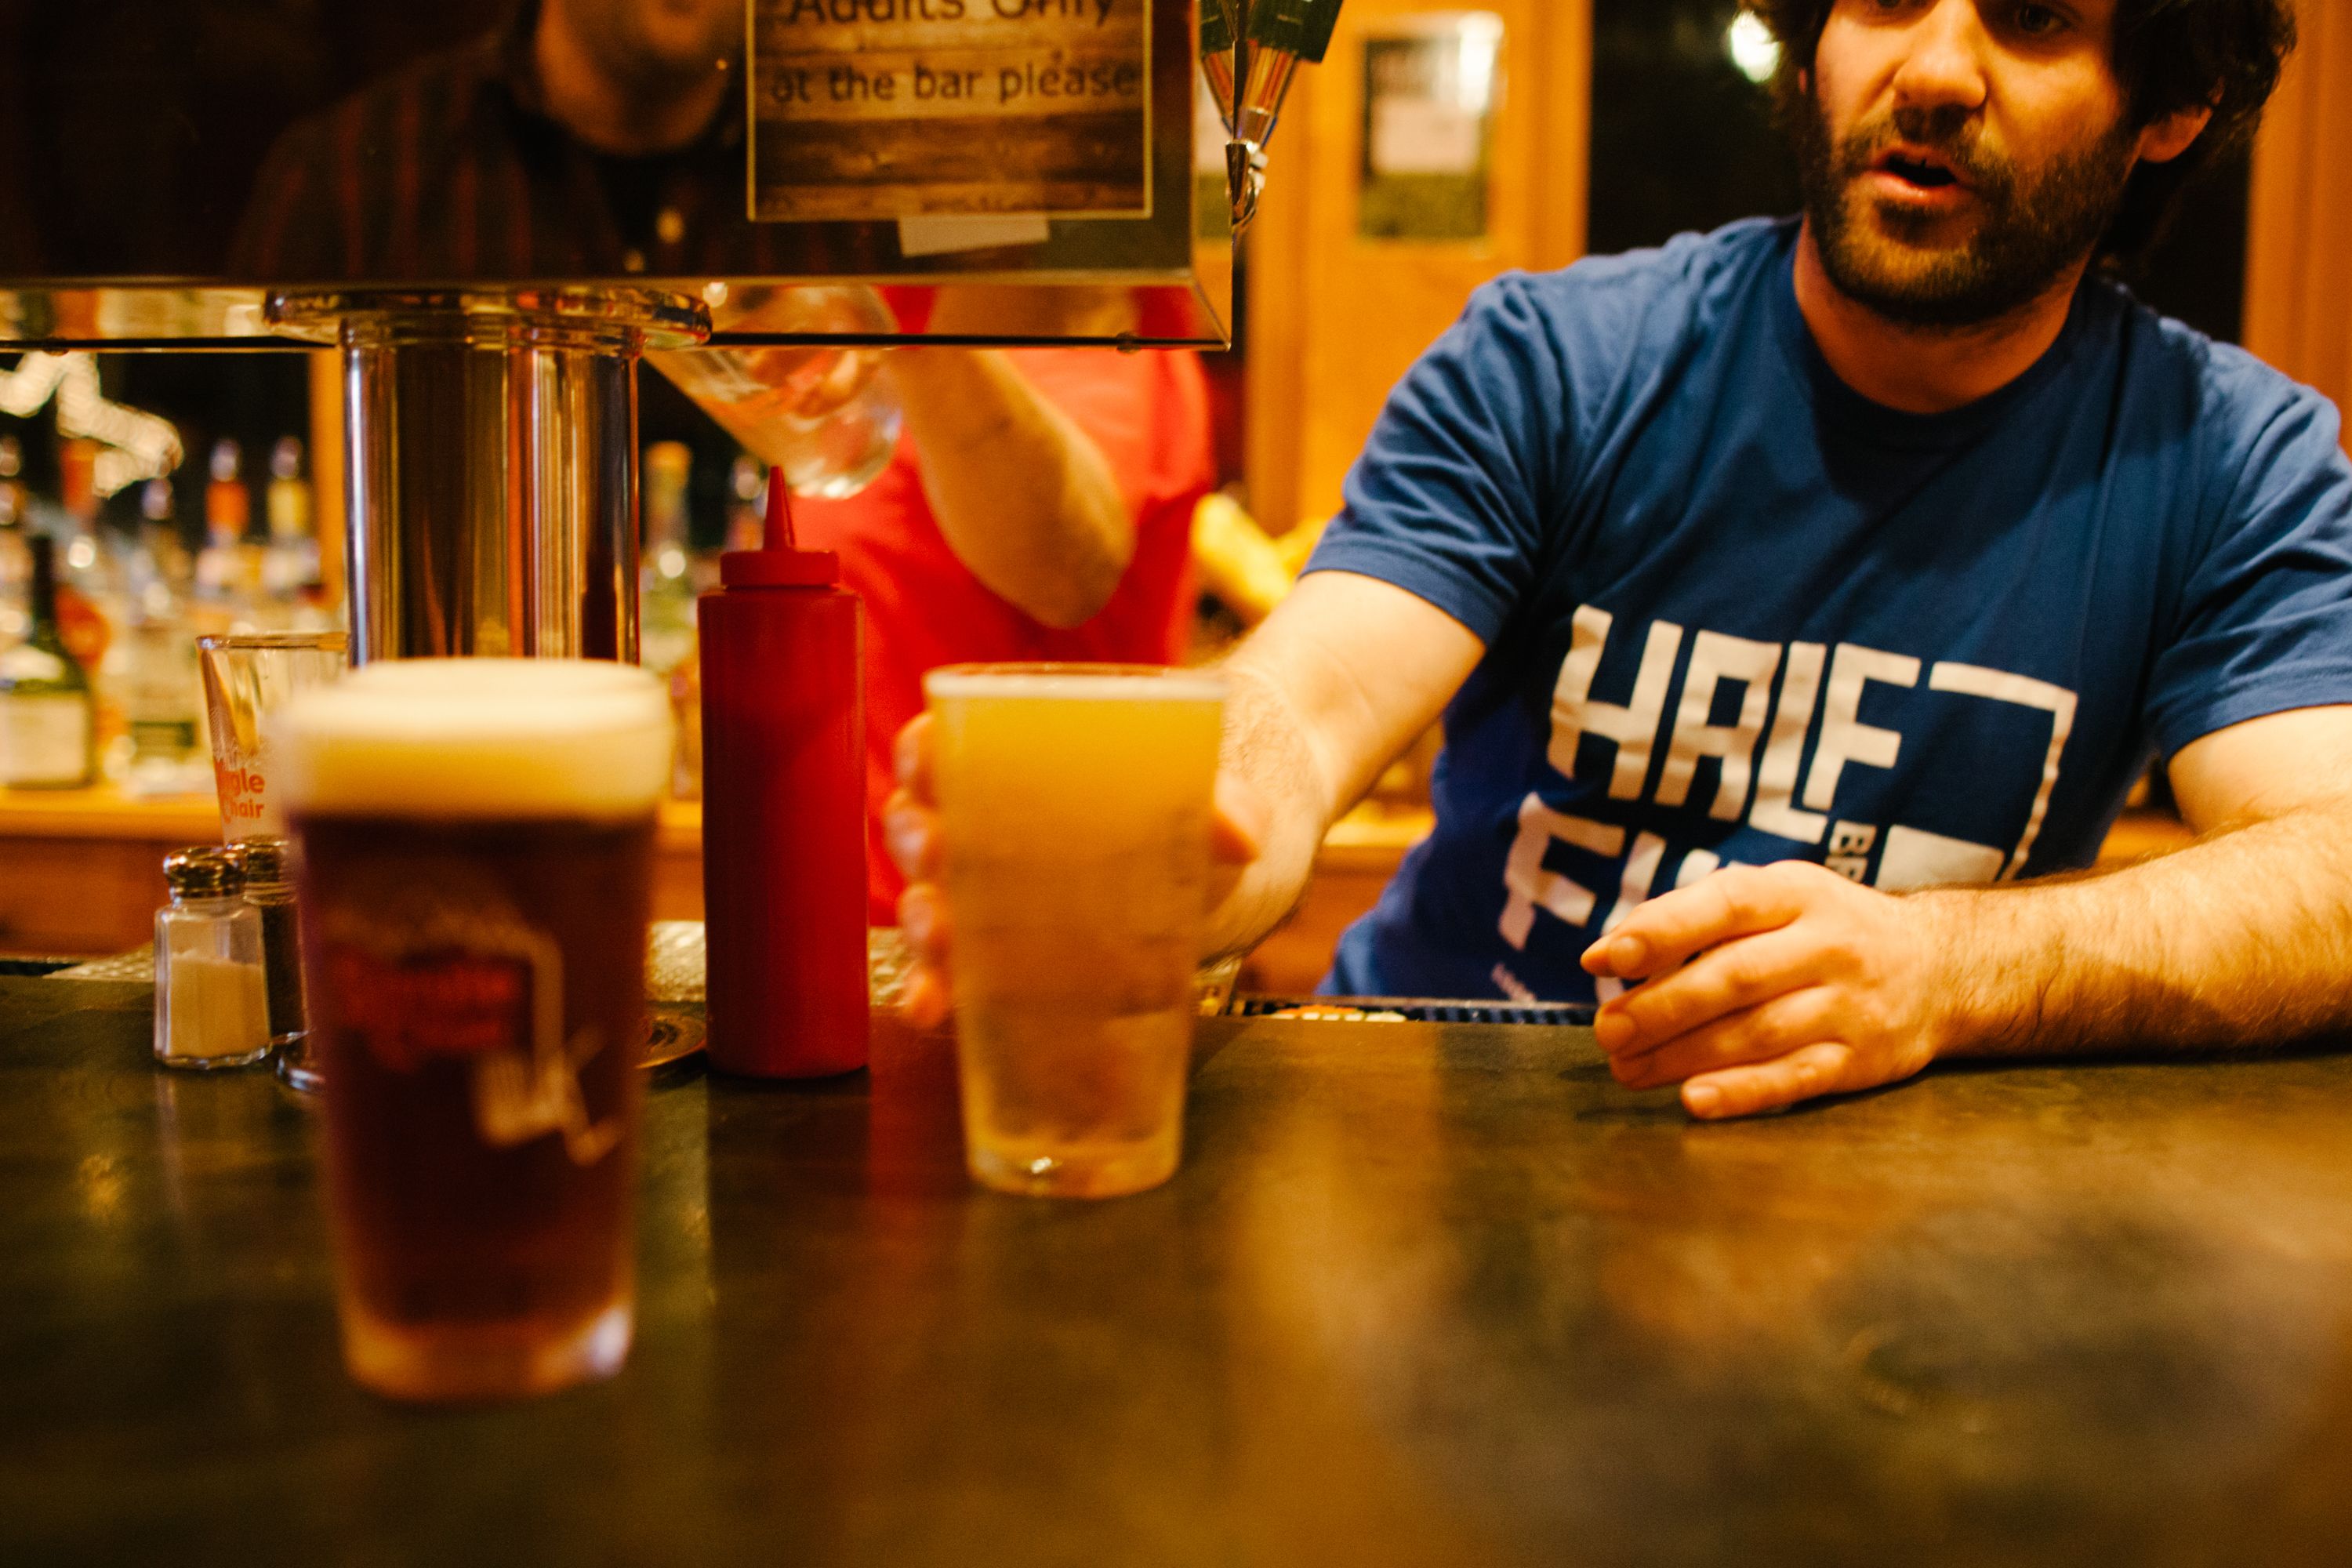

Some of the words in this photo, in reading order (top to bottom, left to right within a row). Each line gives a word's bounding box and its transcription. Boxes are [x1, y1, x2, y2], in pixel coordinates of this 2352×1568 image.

[771, 68, 810, 103] at
[829, 62, 894, 102] the
[914, 60, 983, 100] bar
[1000, 60, 1139, 104] please
[1548, 603, 1921, 844] HALF
